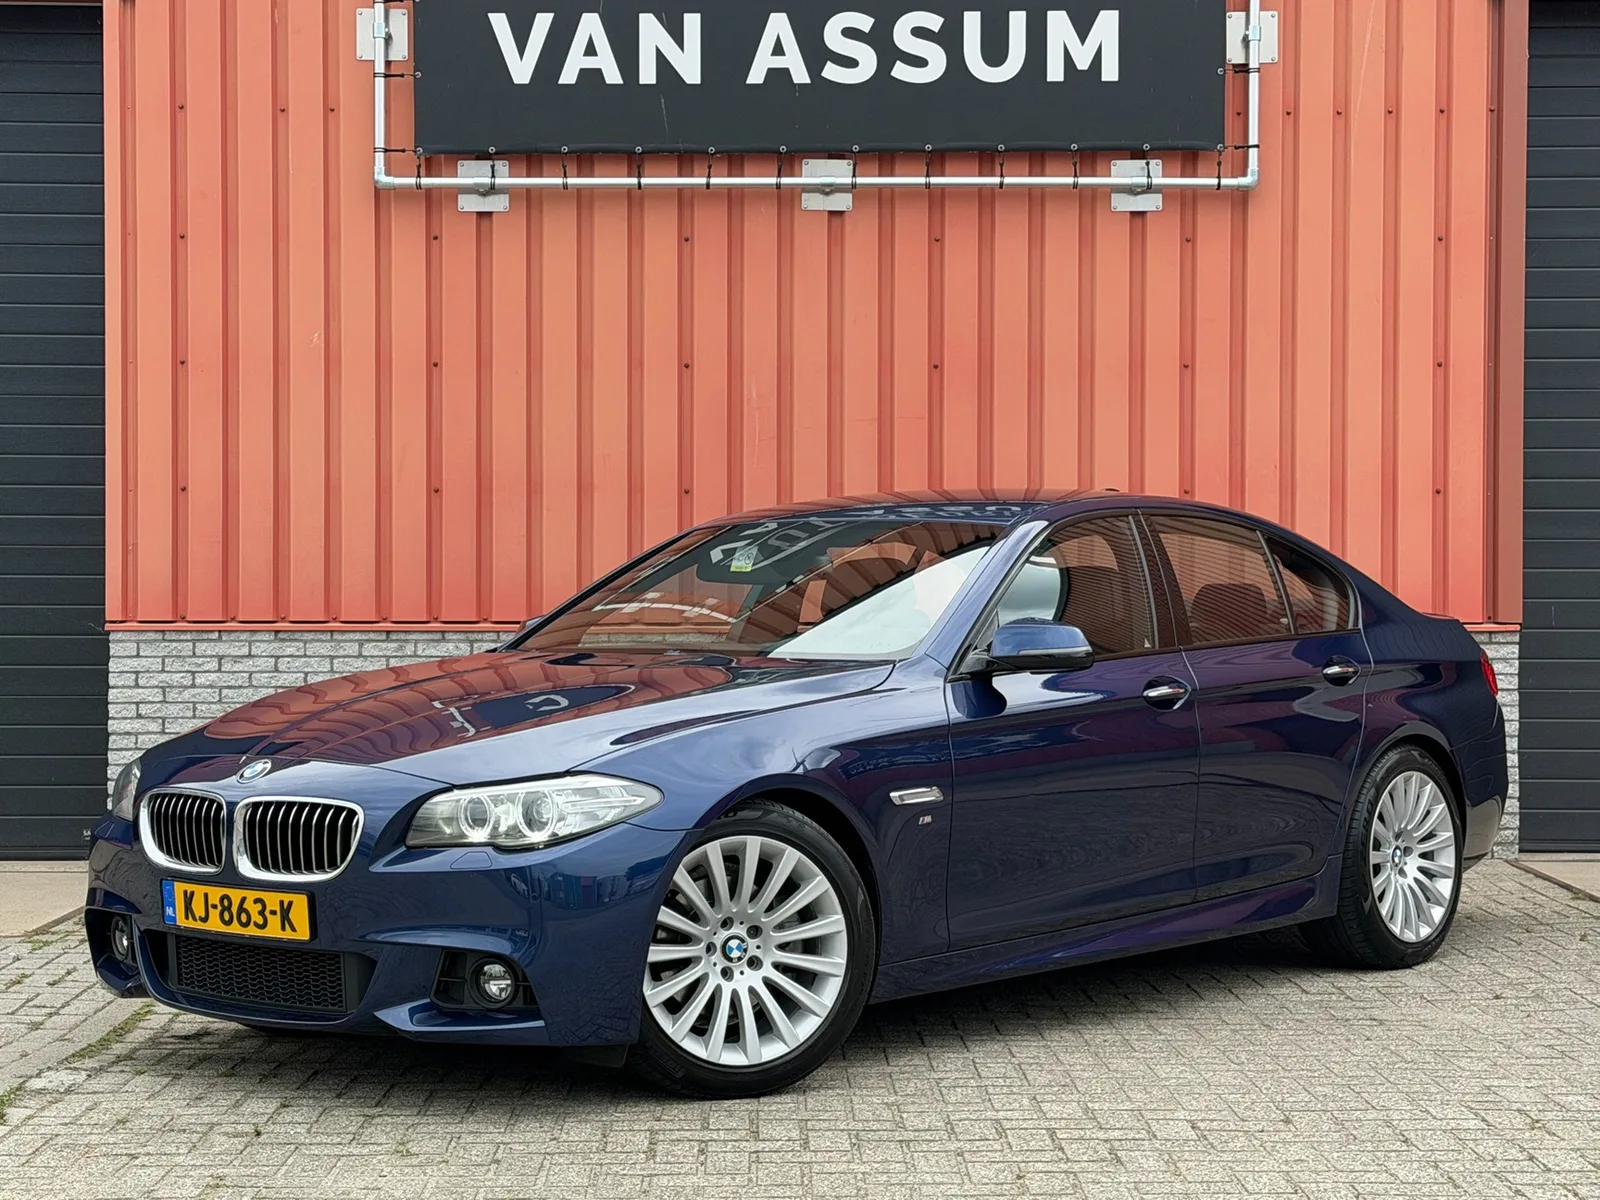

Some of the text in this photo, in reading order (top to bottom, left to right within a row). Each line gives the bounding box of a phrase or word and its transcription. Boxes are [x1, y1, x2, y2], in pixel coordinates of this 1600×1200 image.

[487, 10, 1119, 85] VAN ASSUM
[165, 906, 175, 917] NL
[183, 889, 297, 933] KJ-863-K
